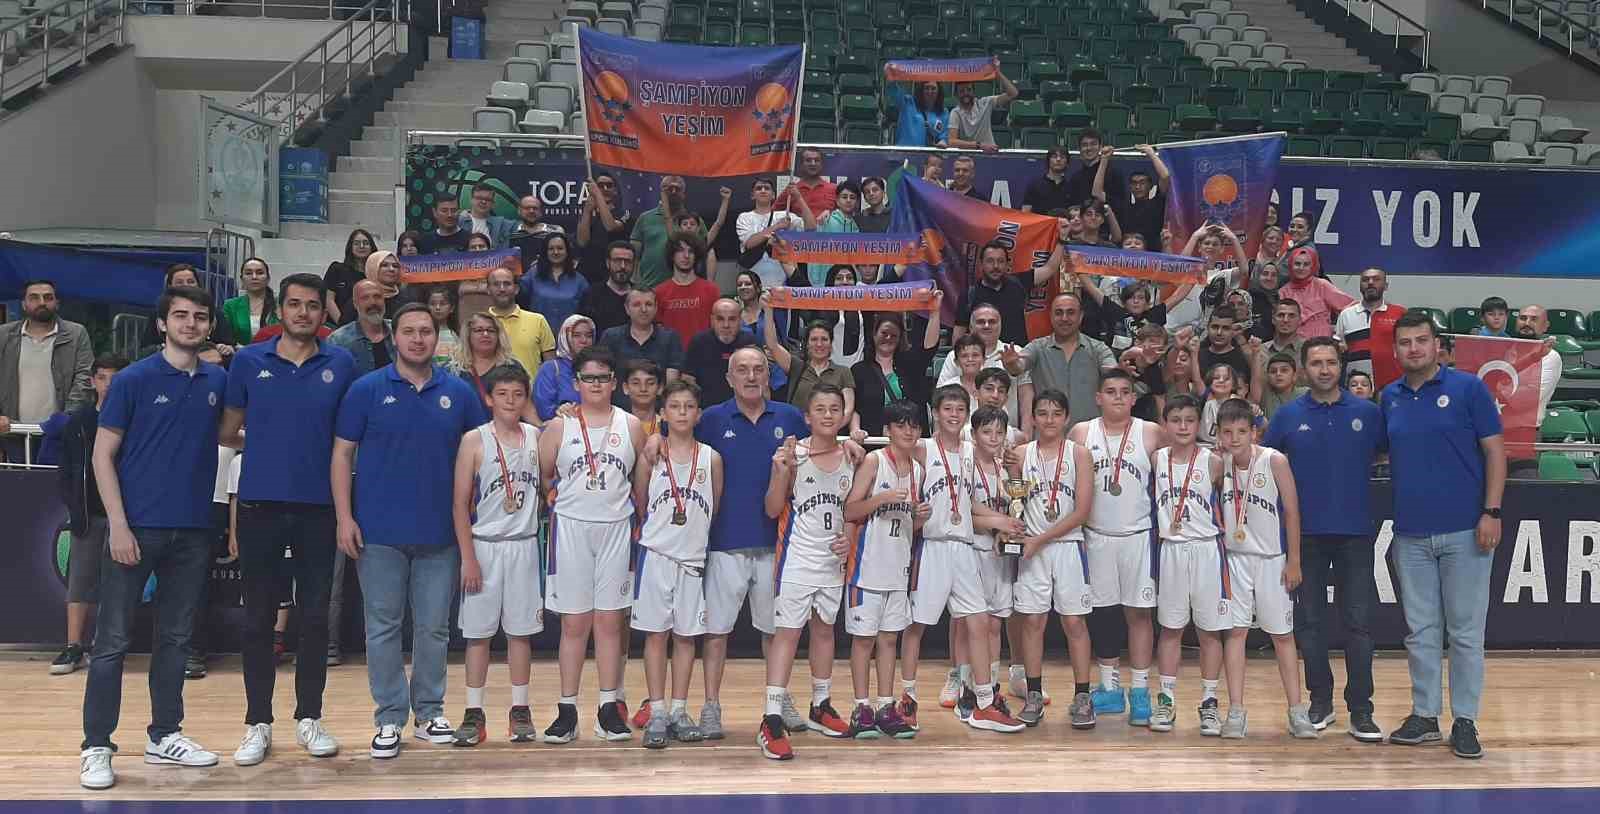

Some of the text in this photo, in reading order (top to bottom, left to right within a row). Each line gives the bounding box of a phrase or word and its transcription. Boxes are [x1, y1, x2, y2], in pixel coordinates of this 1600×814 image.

[639, 79, 747, 108] ŞAMPİYON
[661, 111, 726, 142] YEŞİM
[1371, 190, 1481, 247] YOK
[824, 511, 833, 531] 8
